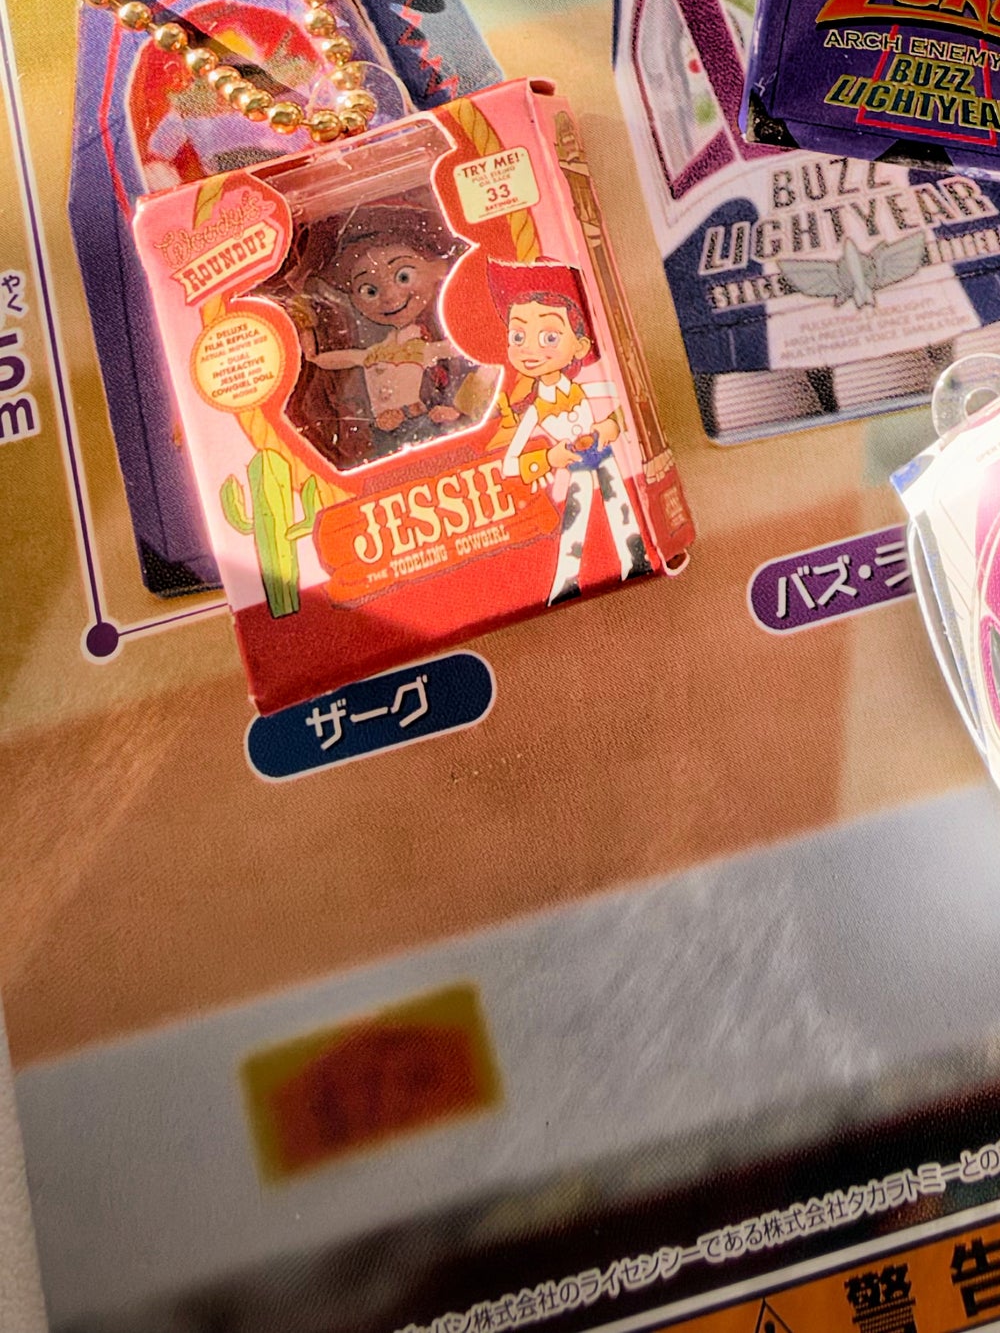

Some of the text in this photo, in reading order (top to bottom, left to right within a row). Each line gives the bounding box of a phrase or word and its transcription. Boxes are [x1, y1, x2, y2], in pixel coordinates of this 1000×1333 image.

[823, 28, 902, 54] ARCH
[888, 53, 976, 96] BUZZ
[462, 152, 520, 178] TRY ME!
[486, 183, 511, 202] 33
[153, 189, 273, 271] Woody's
[702, 176, 1000, 273] LIGHTYEAR
[182, 228, 266, 293] ROUNDUP
[204, 328, 261, 353] FILM REPLICA
[216, 322, 249, 340] DELUXE
[212, 355, 265, 379] INTERACTIVE
[354, 459, 516, 564] JESSIE
[366, 524, 511, 583] THE YODELING COWGIRL
[304, 673, 429, 752] ザーグ
